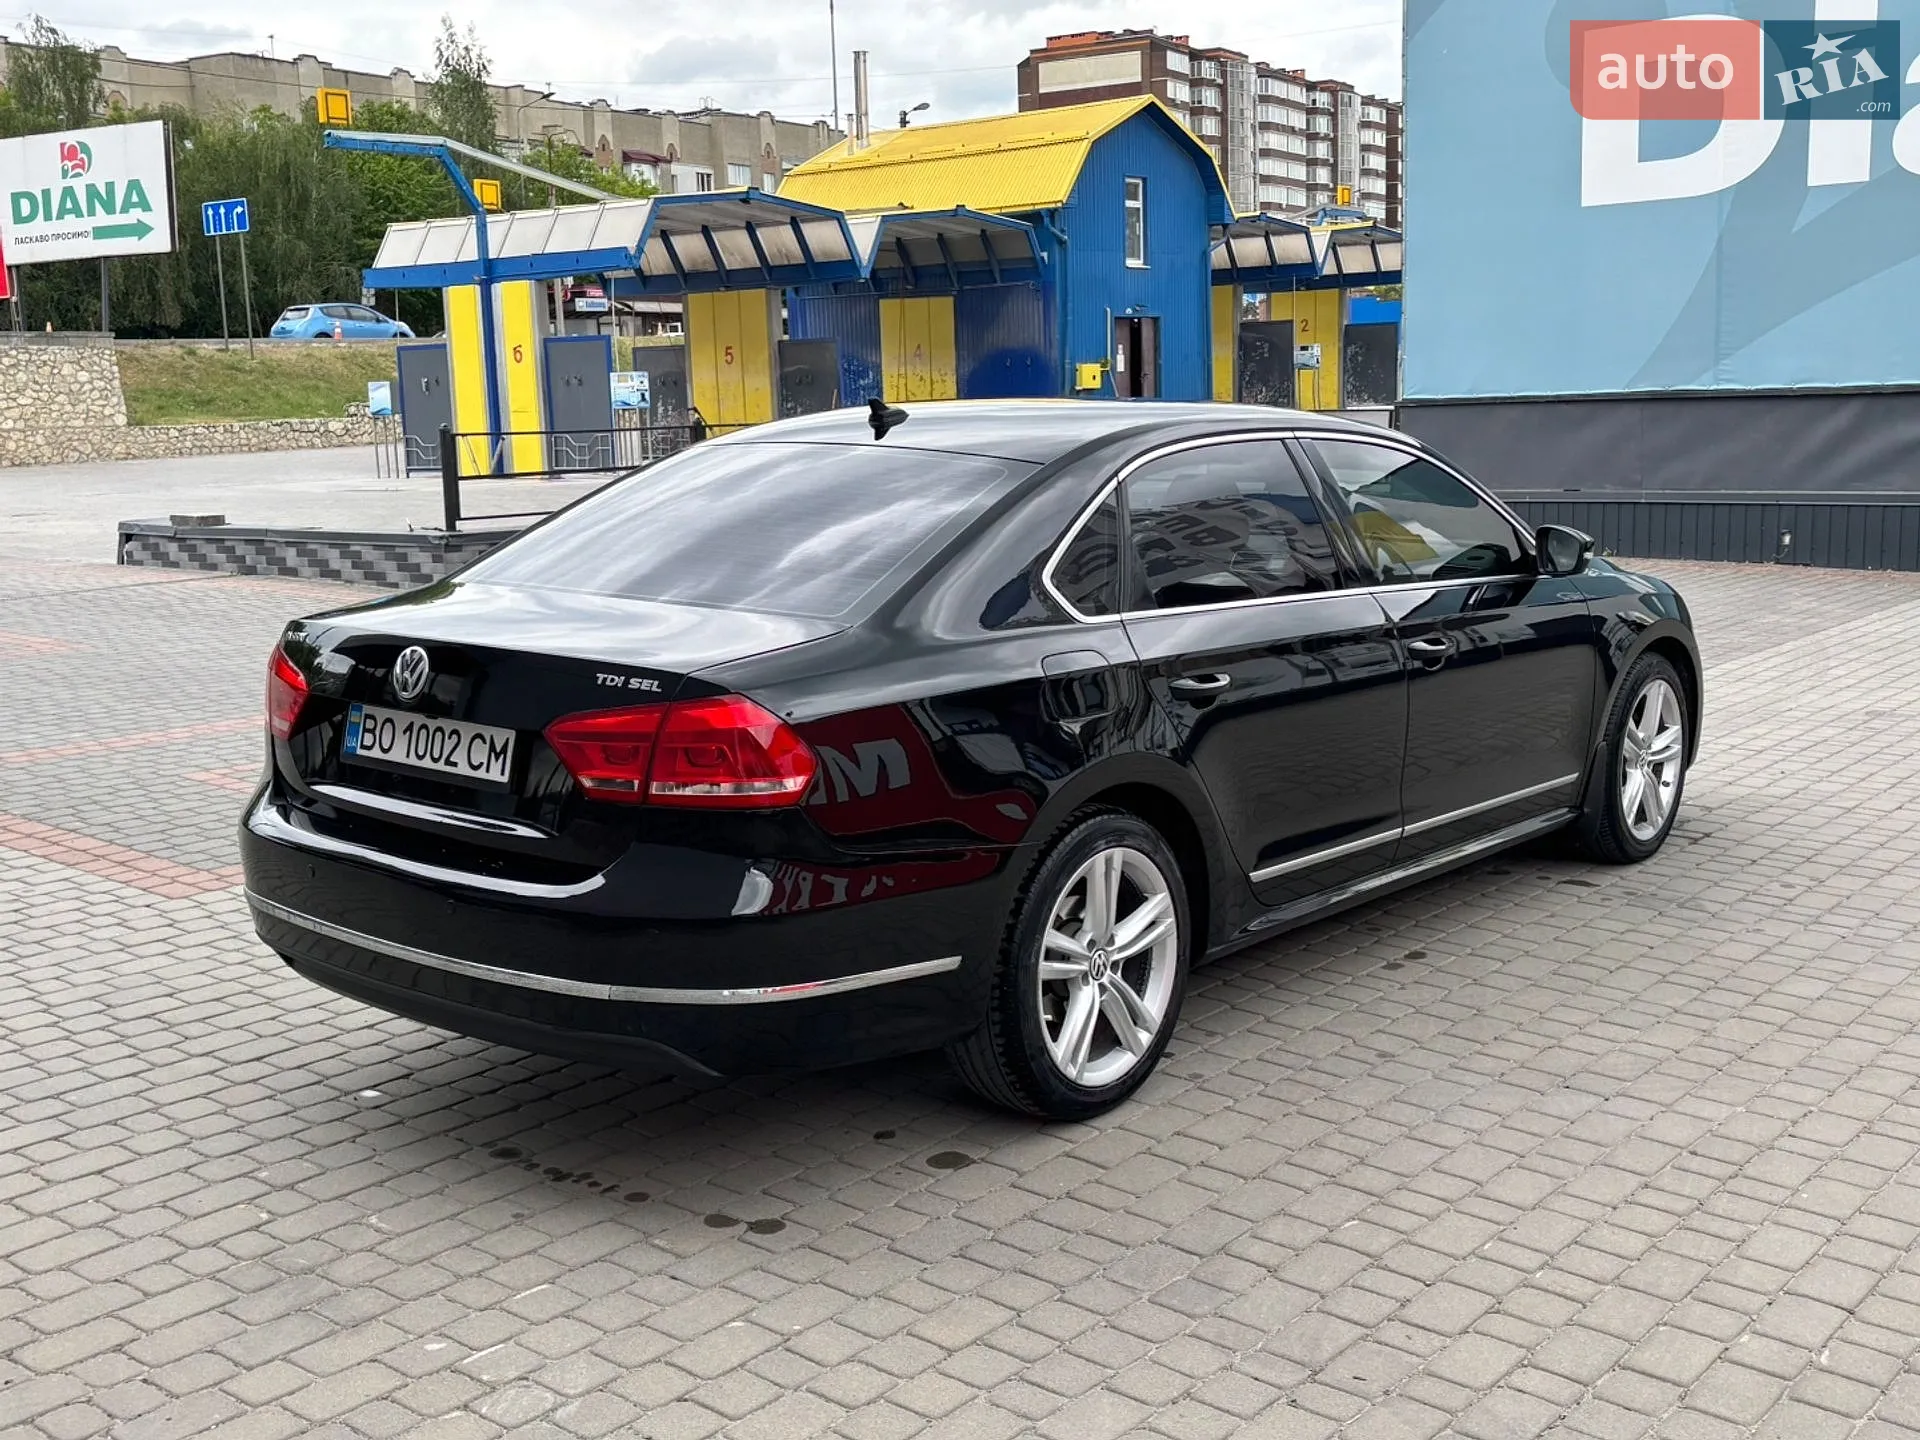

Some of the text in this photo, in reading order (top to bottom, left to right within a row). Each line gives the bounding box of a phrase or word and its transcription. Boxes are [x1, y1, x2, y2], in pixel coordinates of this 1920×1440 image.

[1581, 0, 1920, 208] Di
[11, 178, 153, 225] DIANA
[14, 233, 50, 246] ЛАСКАВО
[1300, 318, 1310, 333] 2
[725, 345, 734, 365] 5
[596, 673, 662, 692] TDI SEL
[360, 713, 510, 777] BO 1002 CM
